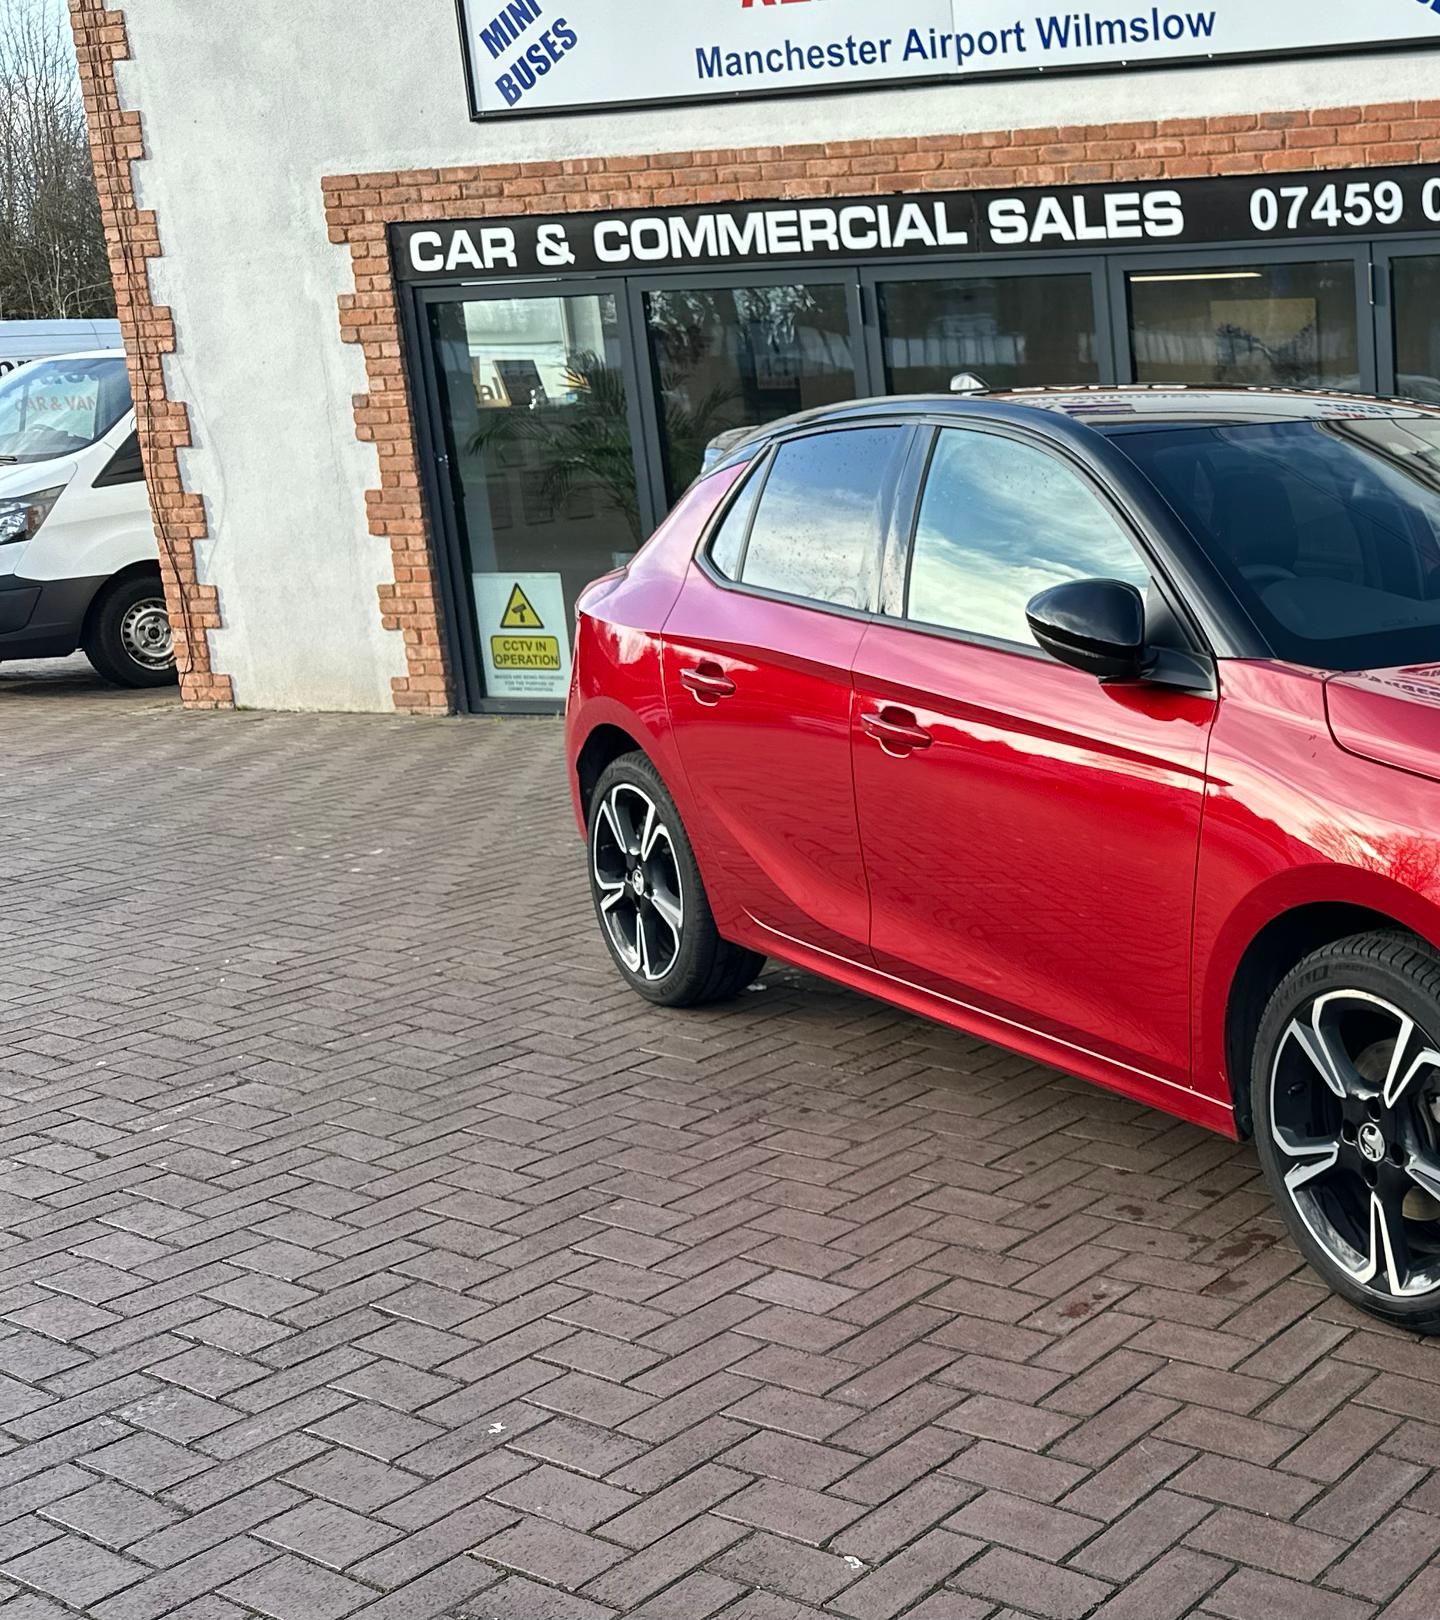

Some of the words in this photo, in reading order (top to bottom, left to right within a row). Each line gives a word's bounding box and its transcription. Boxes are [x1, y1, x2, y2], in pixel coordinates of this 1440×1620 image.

[479, 0, 542, 59] MINI
[695, 35, 893, 79] Manchester
[902, 21, 1026, 66] Airport
[1036, 7, 1217, 50] Wilmslow
[495, 18, 578, 107] BUSES
[409, 226, 518, 273] CAR
[536, 224, 576, 266] &
[594, 200, 968, 263] COMMERCIAL
[987, 189, 1185, 245] SALES
[1249, 179, 1403, 232] 07459
[495, 654, 558, 666] OPERATION
[503, 640, 532, 651] CCTV
[535, 641, 547, 651] IN
